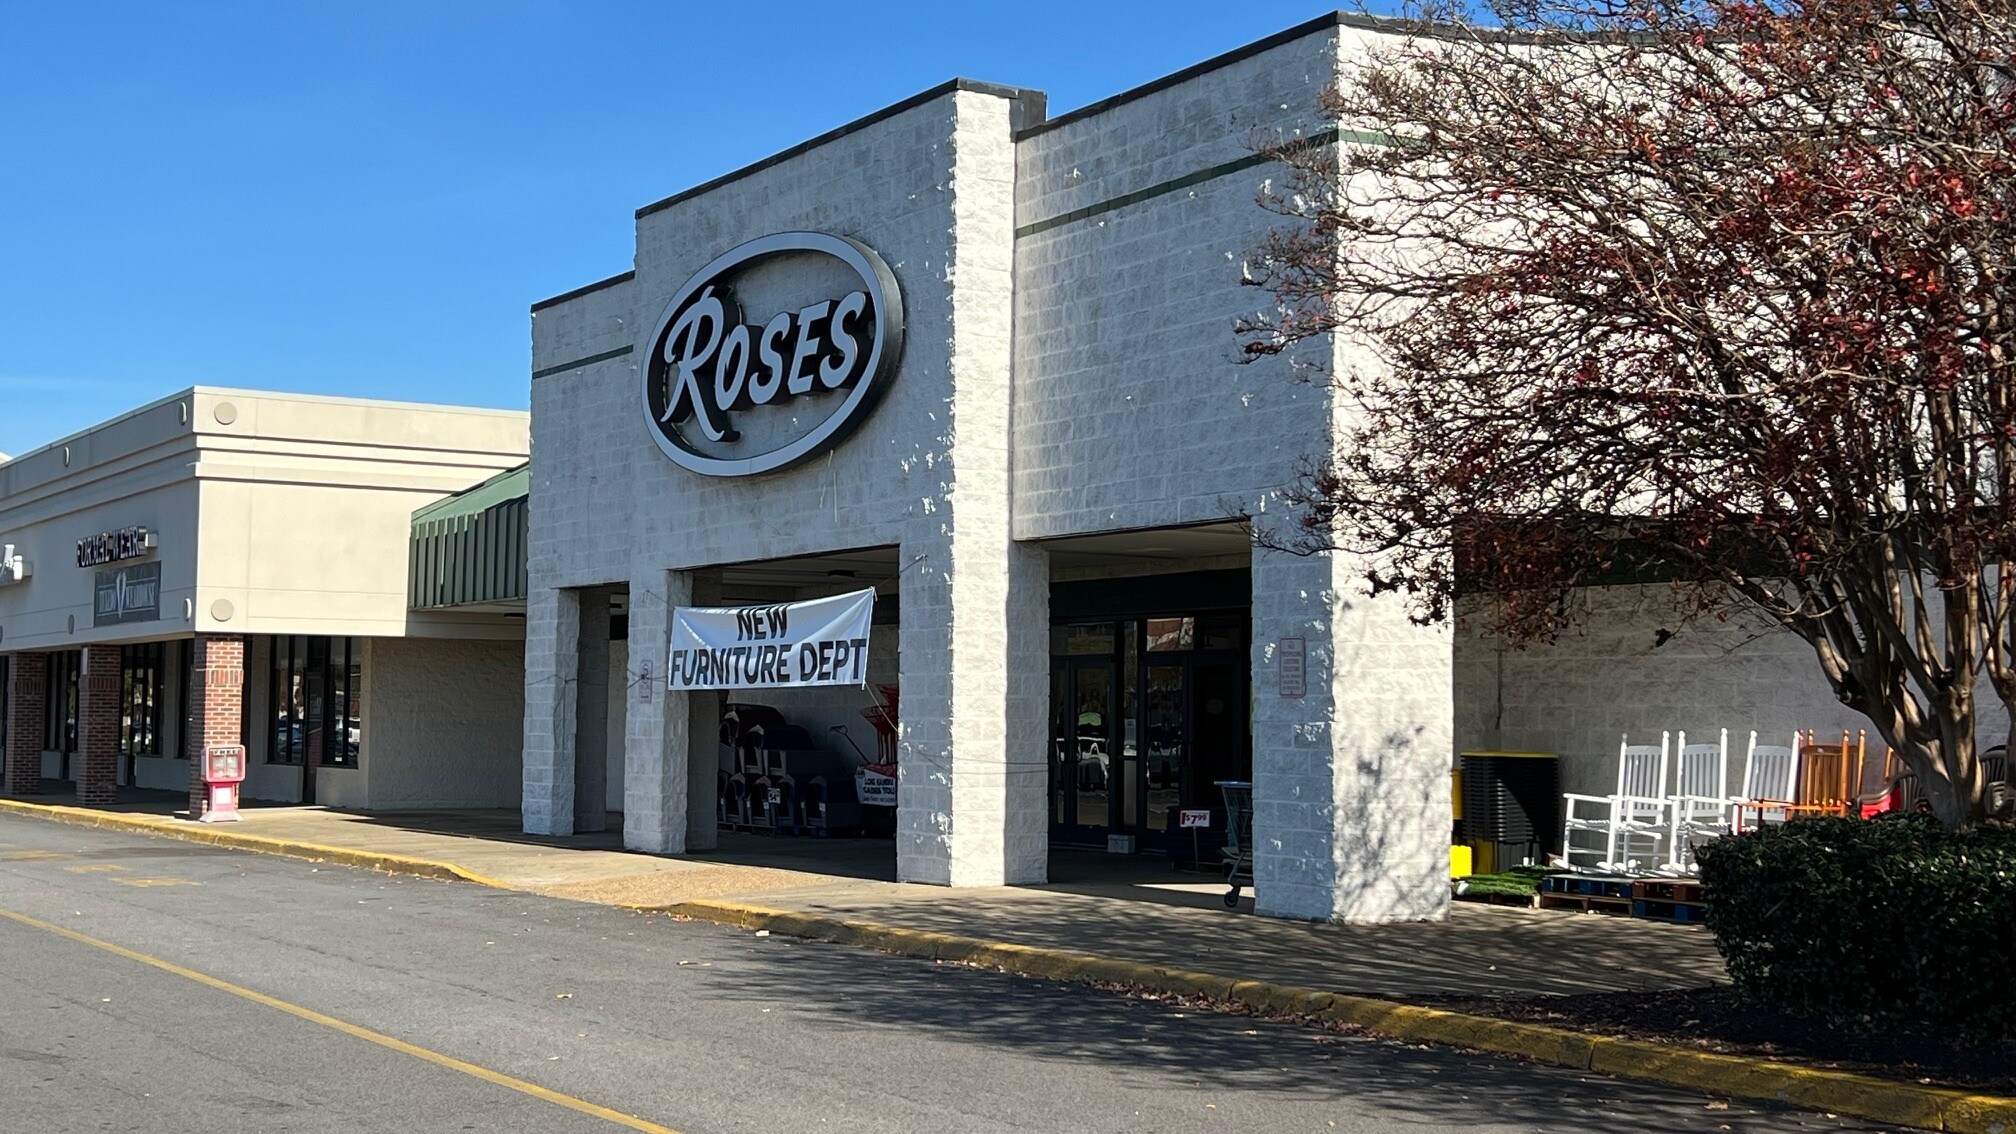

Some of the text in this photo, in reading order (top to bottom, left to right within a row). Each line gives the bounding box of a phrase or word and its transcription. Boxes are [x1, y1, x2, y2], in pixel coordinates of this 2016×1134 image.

[661, 286, 868, 442] ROSES
[736, 604, 791, 642] NEW
[670, 643, 793, 686] FURNITURE
[800, 638, 867, 682] DEPT
